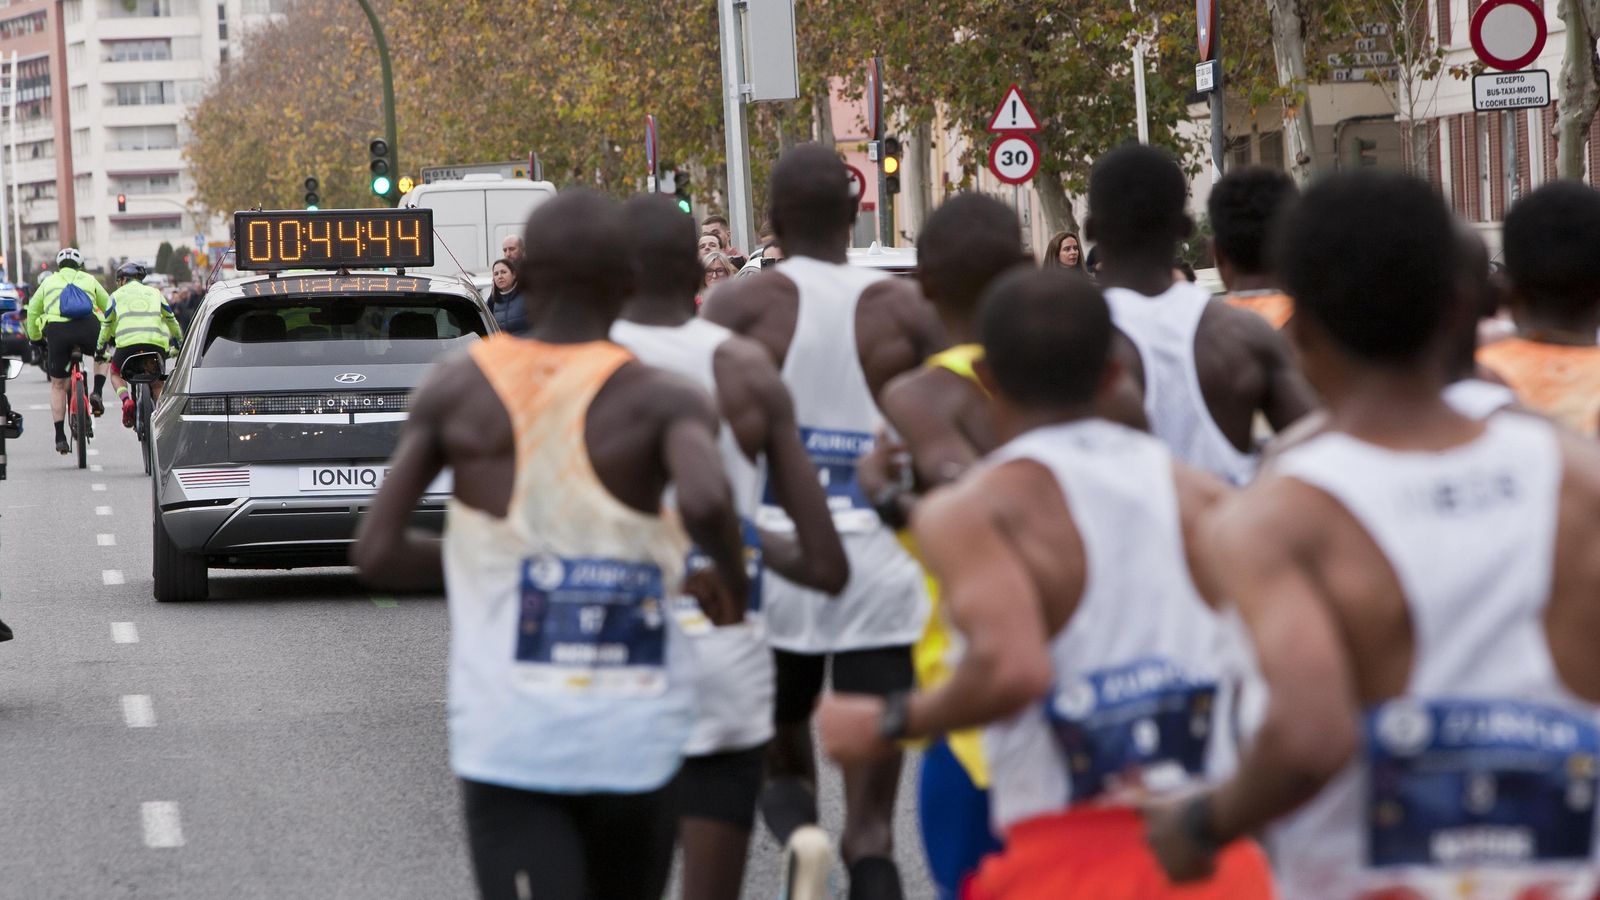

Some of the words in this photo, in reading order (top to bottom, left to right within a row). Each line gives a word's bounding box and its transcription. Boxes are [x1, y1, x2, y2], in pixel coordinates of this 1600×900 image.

[1496, 76, 1525, 84] EXCEPTO
[1487, 86, 1536, 96] BUS-TAXI-MOTO
[1480, 100, 1484, 108] Y
[1485, 99, 1508, 107] COCHE
[1001, 150, 1028, 166] 30
[424, 170, 457, 179] HOTEL
[249, 219, 420, 261] 00:44:44
[313, 468, 376, 487] IONIQ
